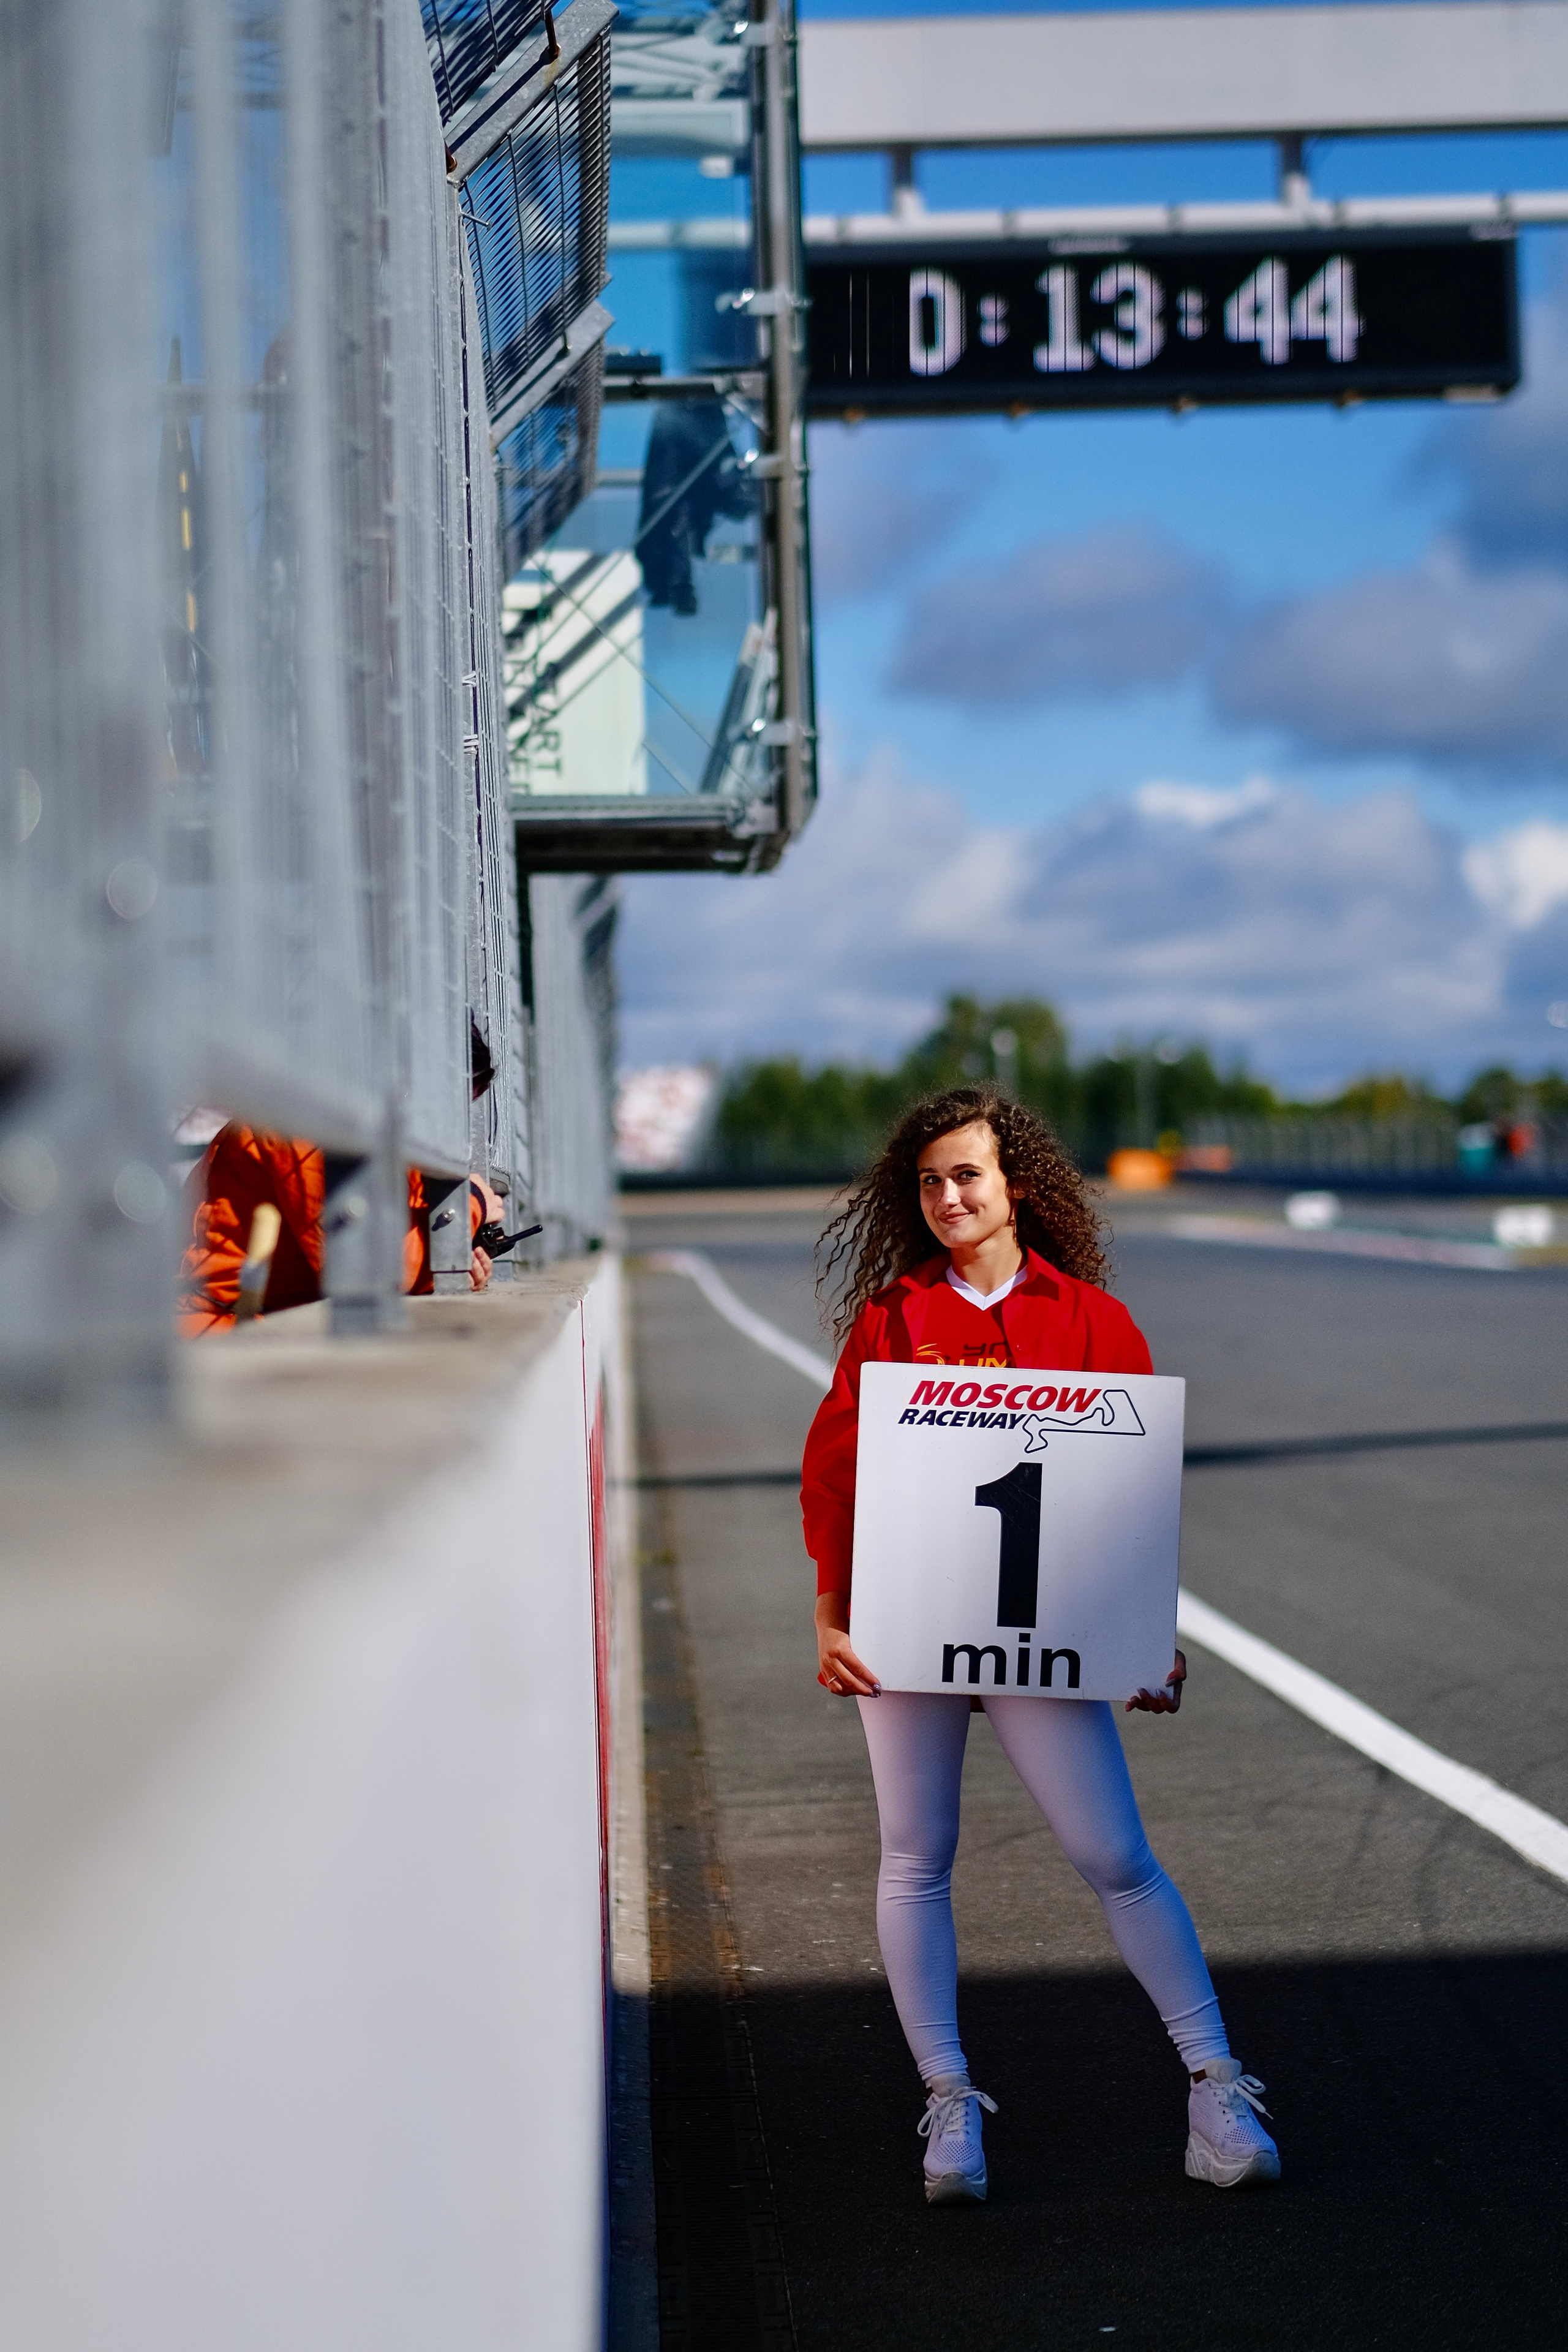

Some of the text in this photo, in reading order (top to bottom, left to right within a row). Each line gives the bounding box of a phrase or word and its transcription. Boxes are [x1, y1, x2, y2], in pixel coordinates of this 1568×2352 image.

[909, 253, 1365, 376] 0:13:44
[897, 1408, 1028, 1430] RACEWAY
[908, 1380, 1102, 1413] MOSCOW
[974, 1461, 1043, 1629] 1
[941, 1632, 1081, 1689] min
